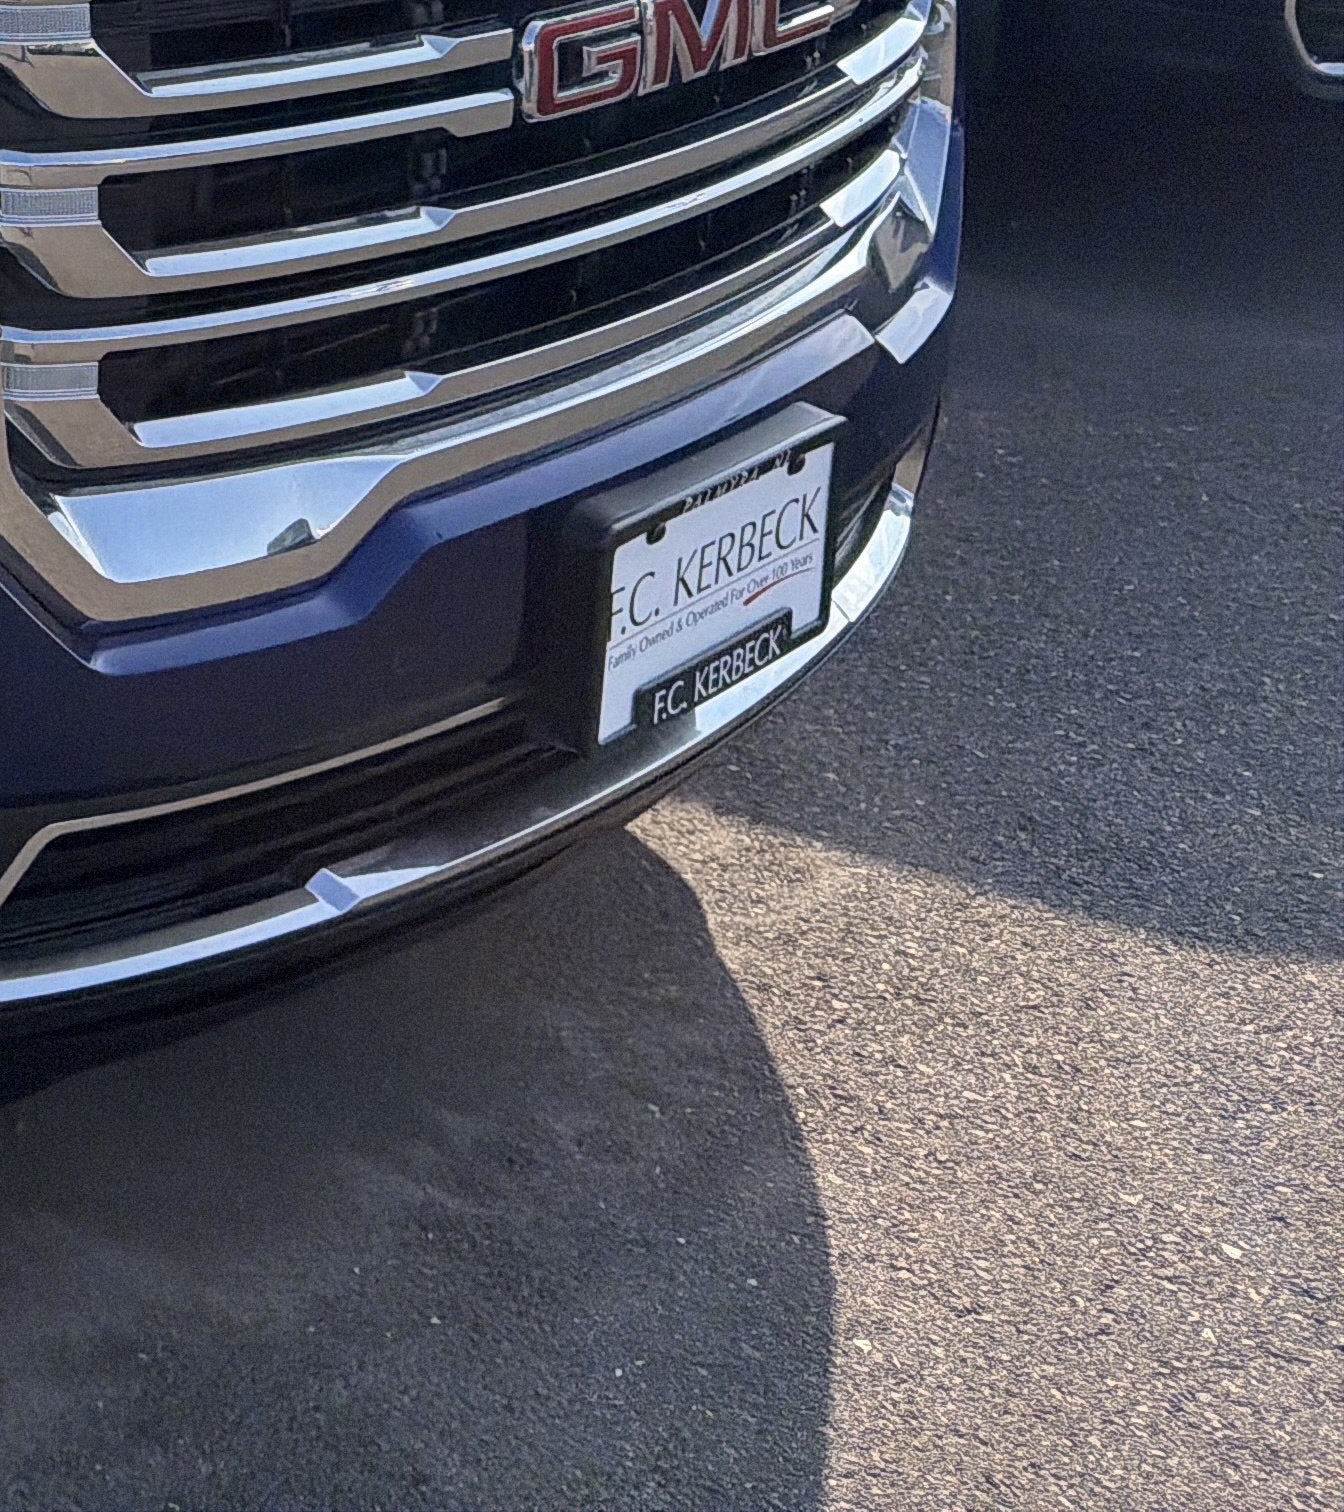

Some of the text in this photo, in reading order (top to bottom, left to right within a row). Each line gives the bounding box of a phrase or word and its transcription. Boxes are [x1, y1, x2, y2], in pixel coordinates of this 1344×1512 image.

[673, 486, 822, 607] KERBECK
[608, 554, 814, 671] Family Owned & Operated For Over 100 Years
[653, 624, 783, 725] F.C. KERBECK
